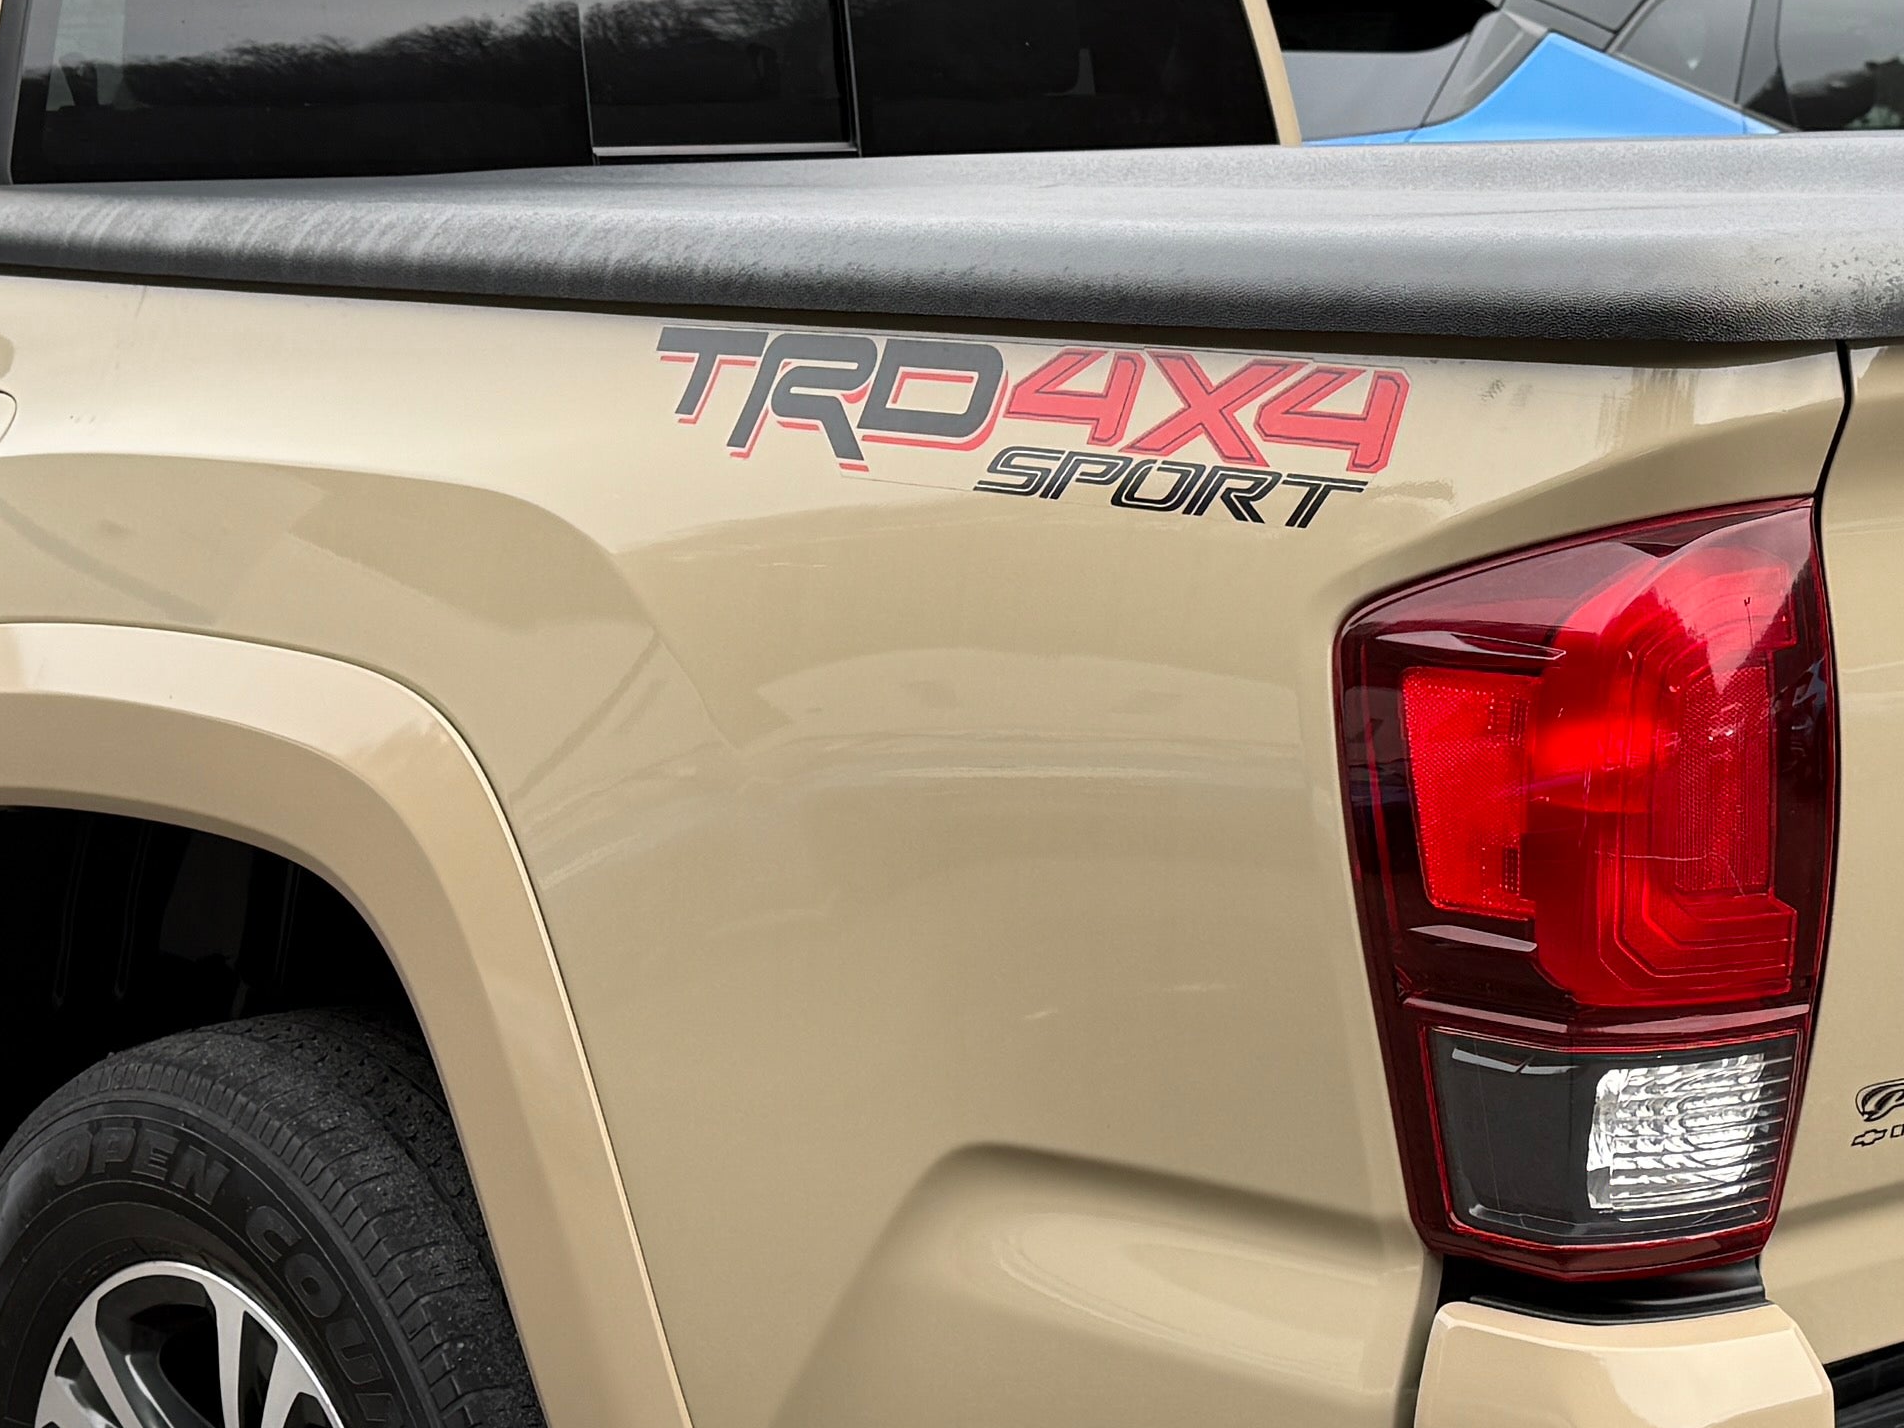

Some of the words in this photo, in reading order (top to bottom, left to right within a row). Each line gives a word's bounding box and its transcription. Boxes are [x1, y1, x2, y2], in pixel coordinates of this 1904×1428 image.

[656, 325, 1010, 472] TRD
[1002, 345, 1415, 474] 4X4
[972, 445, 1369, 530] SPORT
[52, 1118, 238, 1209] OPEN
